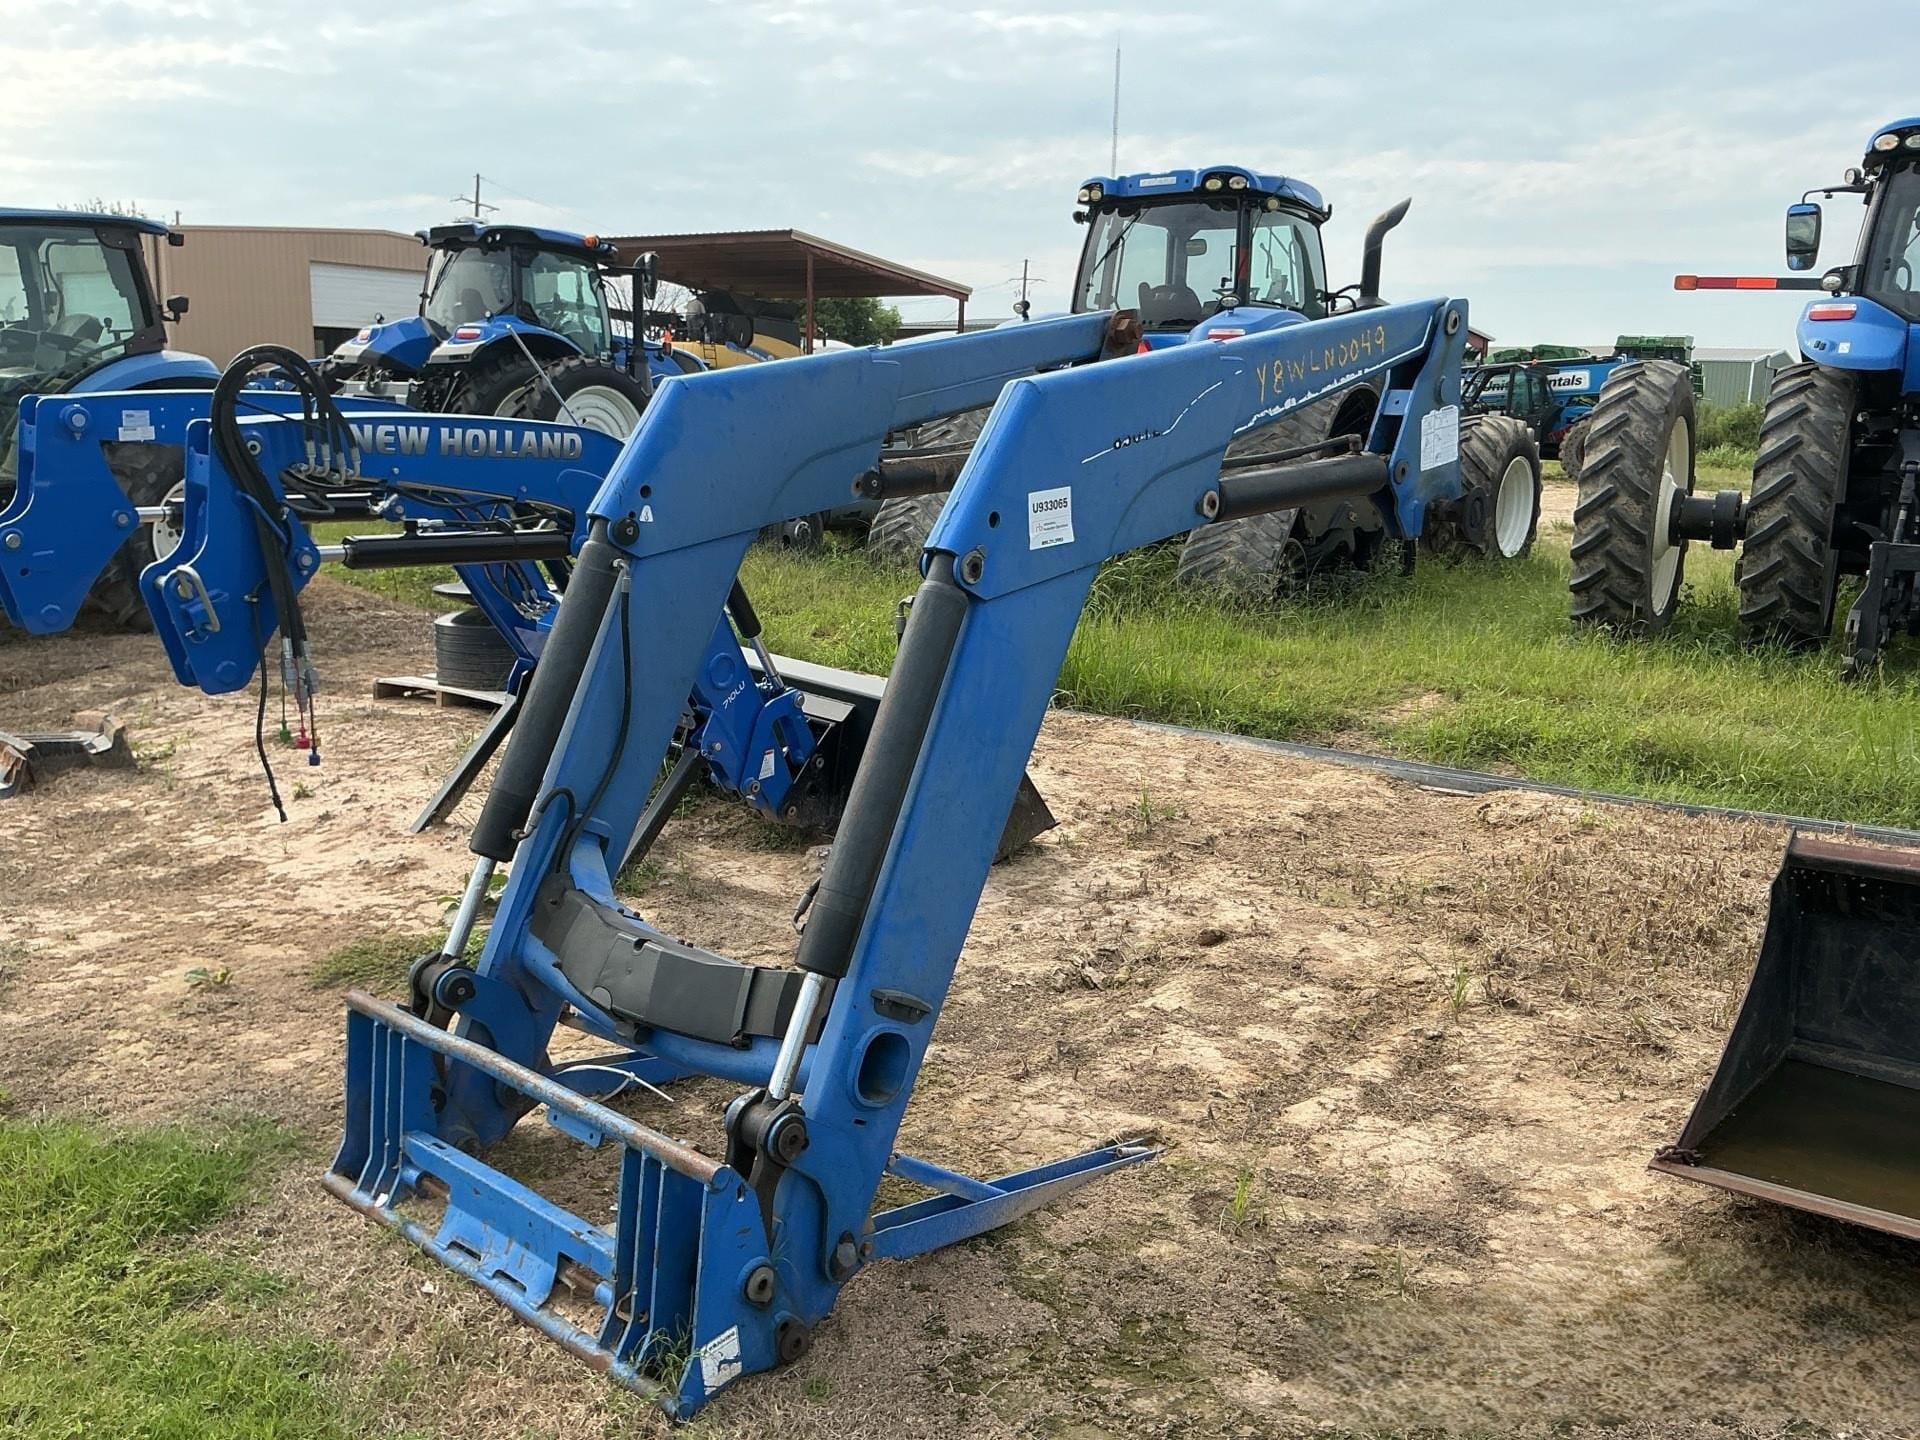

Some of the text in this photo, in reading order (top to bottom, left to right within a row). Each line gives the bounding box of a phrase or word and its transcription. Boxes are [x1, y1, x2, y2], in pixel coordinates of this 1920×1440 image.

[1551, 374, 1583, 388] ntals
[349, 423, 583, 460] NEW HOLLAND
[1032, 497, 1069, 514] U933065
